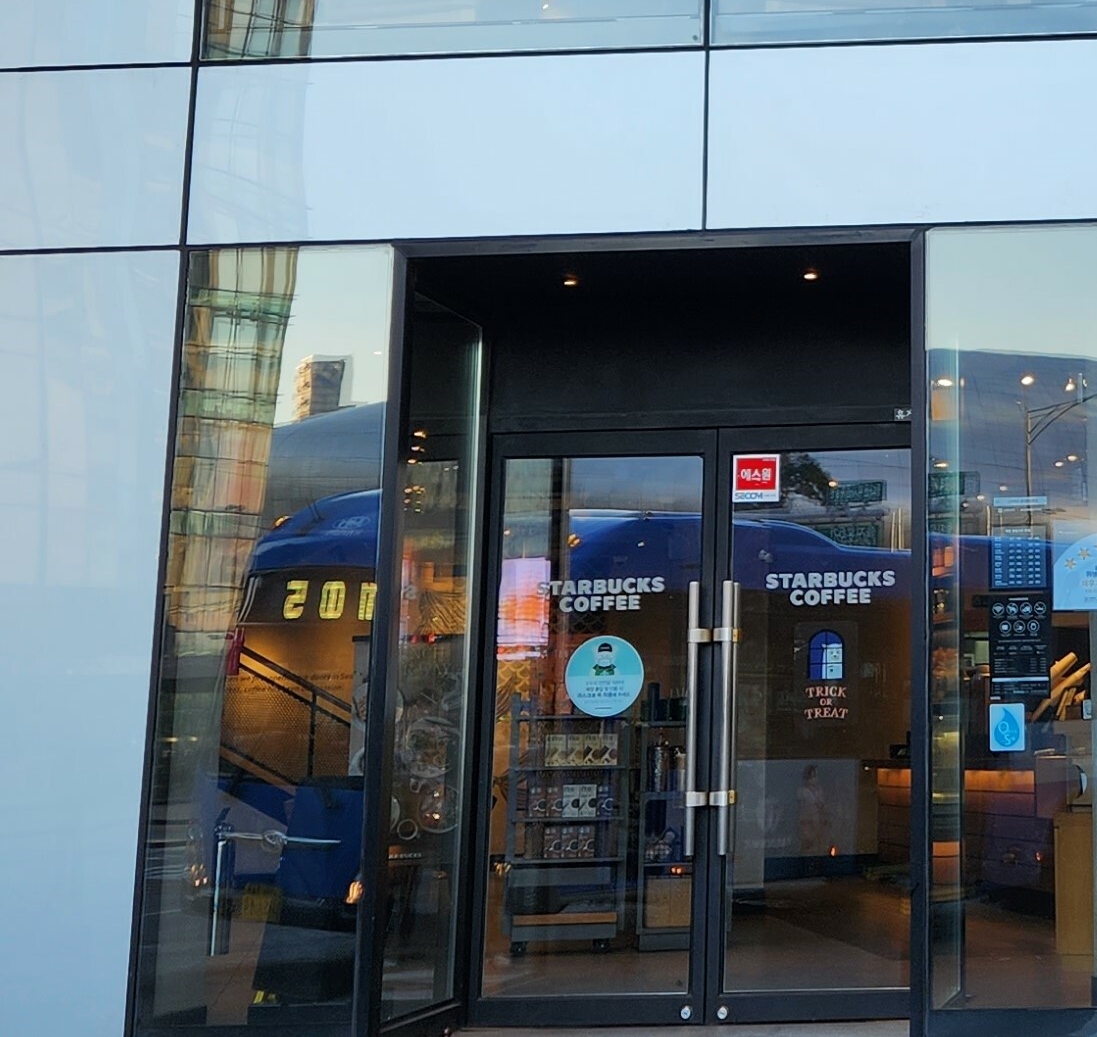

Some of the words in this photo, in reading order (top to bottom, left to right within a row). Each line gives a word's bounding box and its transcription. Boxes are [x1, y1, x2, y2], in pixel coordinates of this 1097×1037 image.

[740, 467, 772, 482] 에스원
[734, 491, 763, 500] SECOM
[536, 576, 665, 596] STARBUCKS
[764, 570, 896, 590] STARBUCKS
[559, 594, 641, 613] COFFEE
[789, 588, 872, 606] COFFEE
[805, 685, 847, 699] TRICK
[819, 697, 833, 707] OR
[803, 707, 849, 720] TREAT
